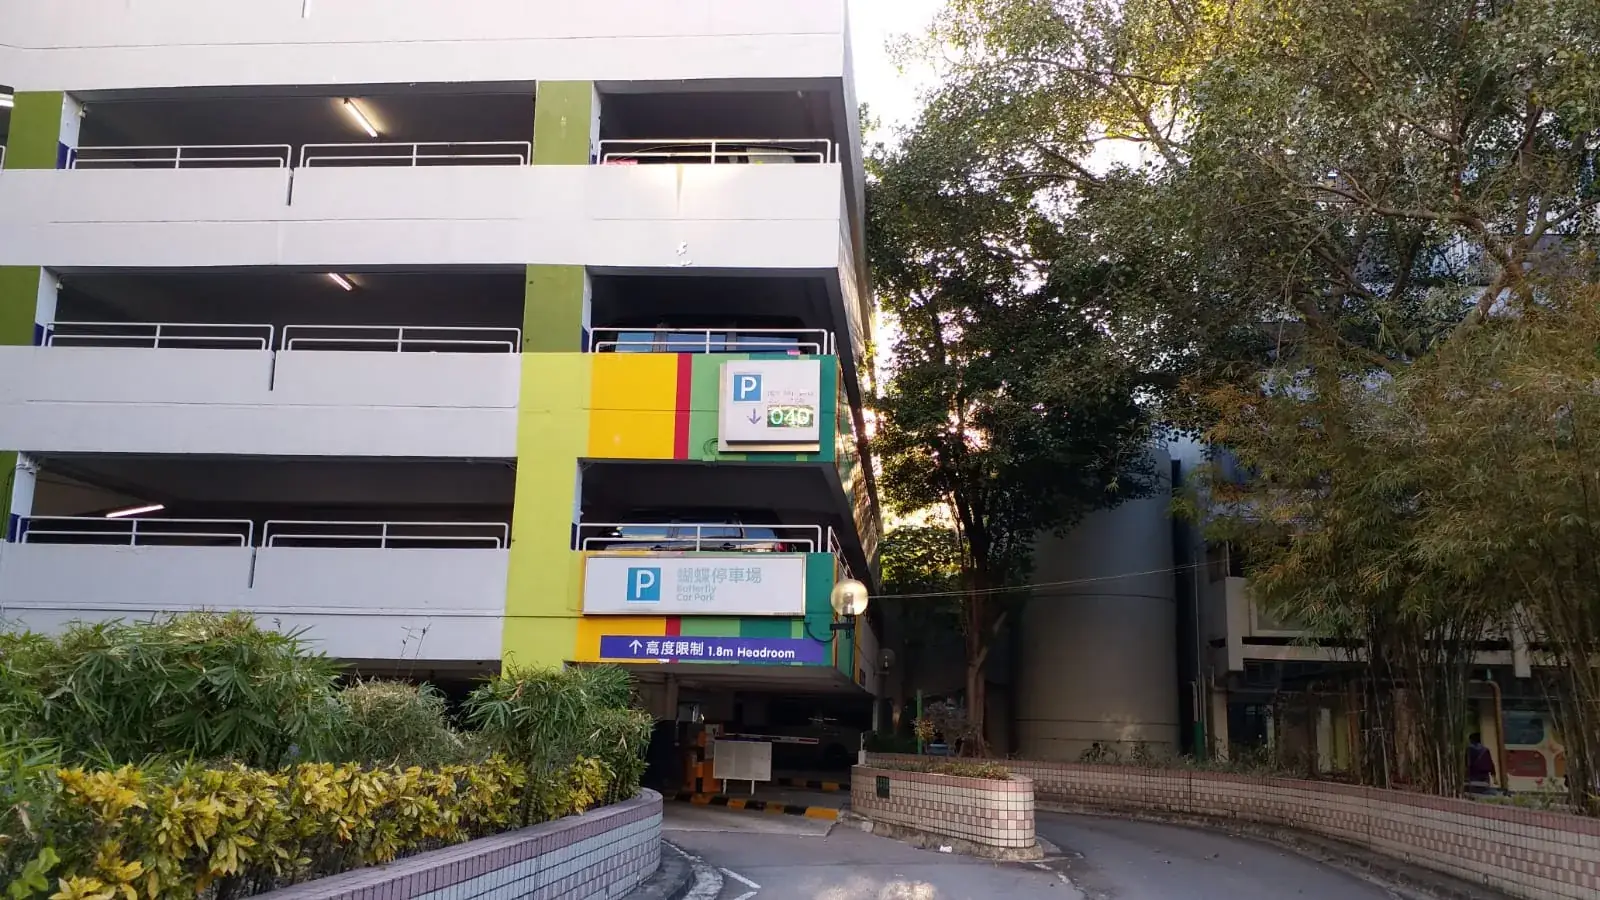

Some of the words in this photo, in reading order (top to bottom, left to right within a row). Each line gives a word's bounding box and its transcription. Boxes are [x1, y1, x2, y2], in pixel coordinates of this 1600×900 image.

[740, 375, 757, 400] P
[677, 567, 763, 583] 蝴蝶停車場
[635, 569, 655, 599] P
[676, 584, 717, 594] Butterfly
[676, 593, 692, 602] Car
[694, 593, 715, 601] Park
[646, 640, 704, 656] 高度限制
[707, 646, 734, 657] 1.8m
[737, 647, 795, 659] Headroom
